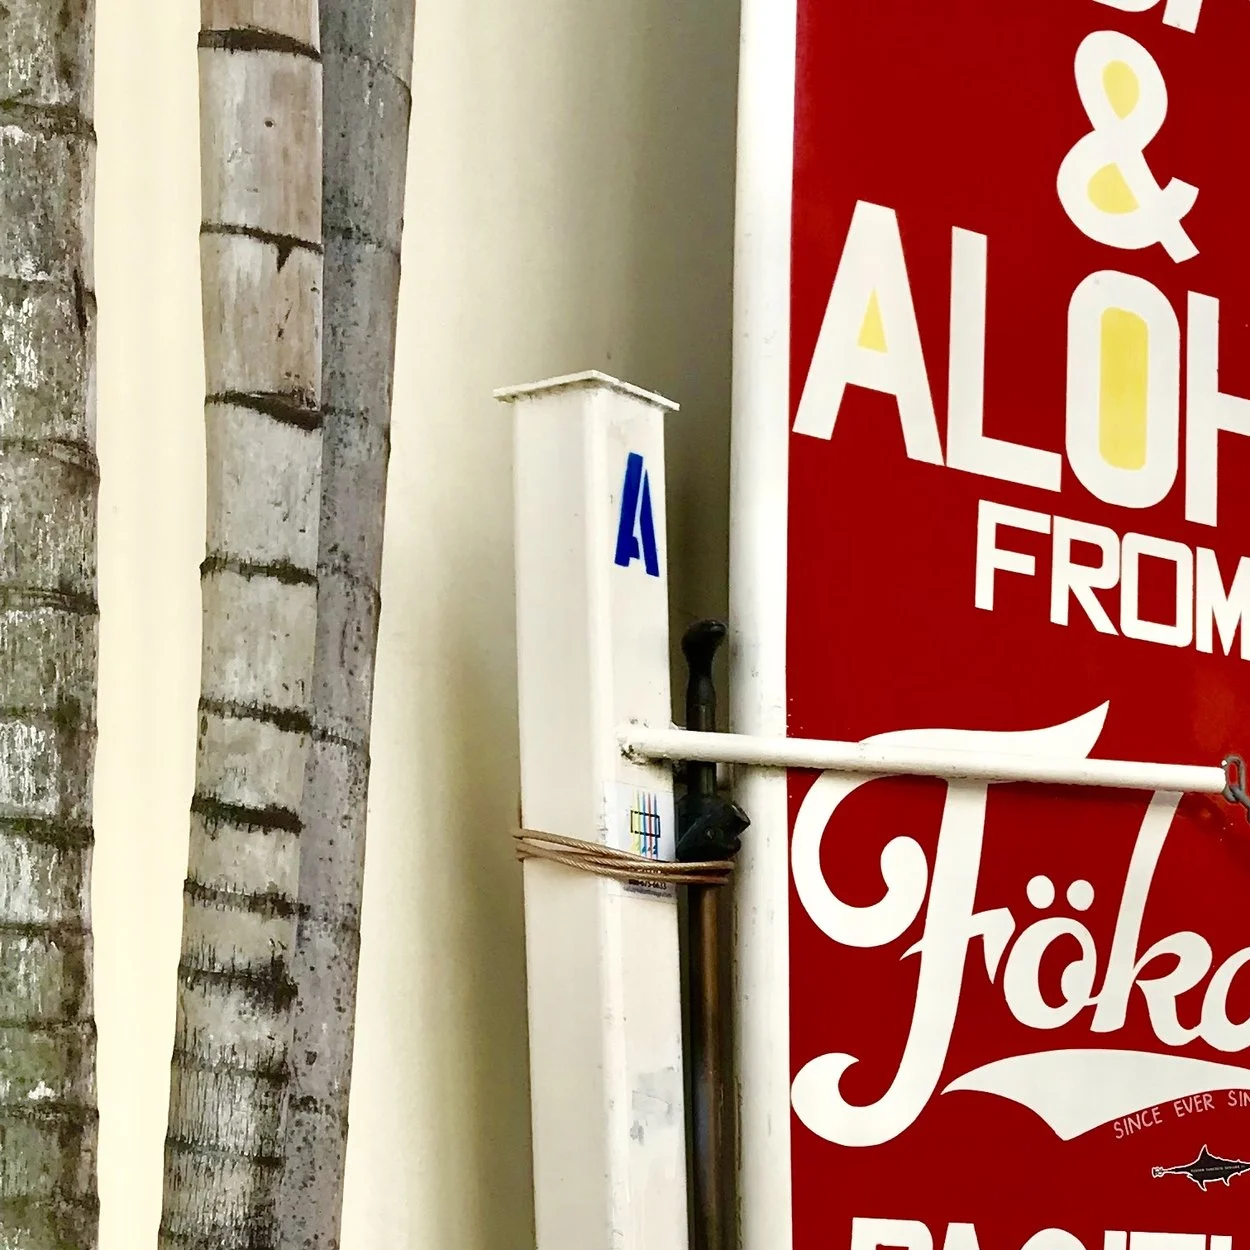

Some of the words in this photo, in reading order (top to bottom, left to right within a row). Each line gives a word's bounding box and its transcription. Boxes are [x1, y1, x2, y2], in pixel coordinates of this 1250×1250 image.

[1057, 31, 1199, 263] &
[1113, 1106, 1163, 1139] SINCE
[1173, 1093, 1215, 1118] EVER
